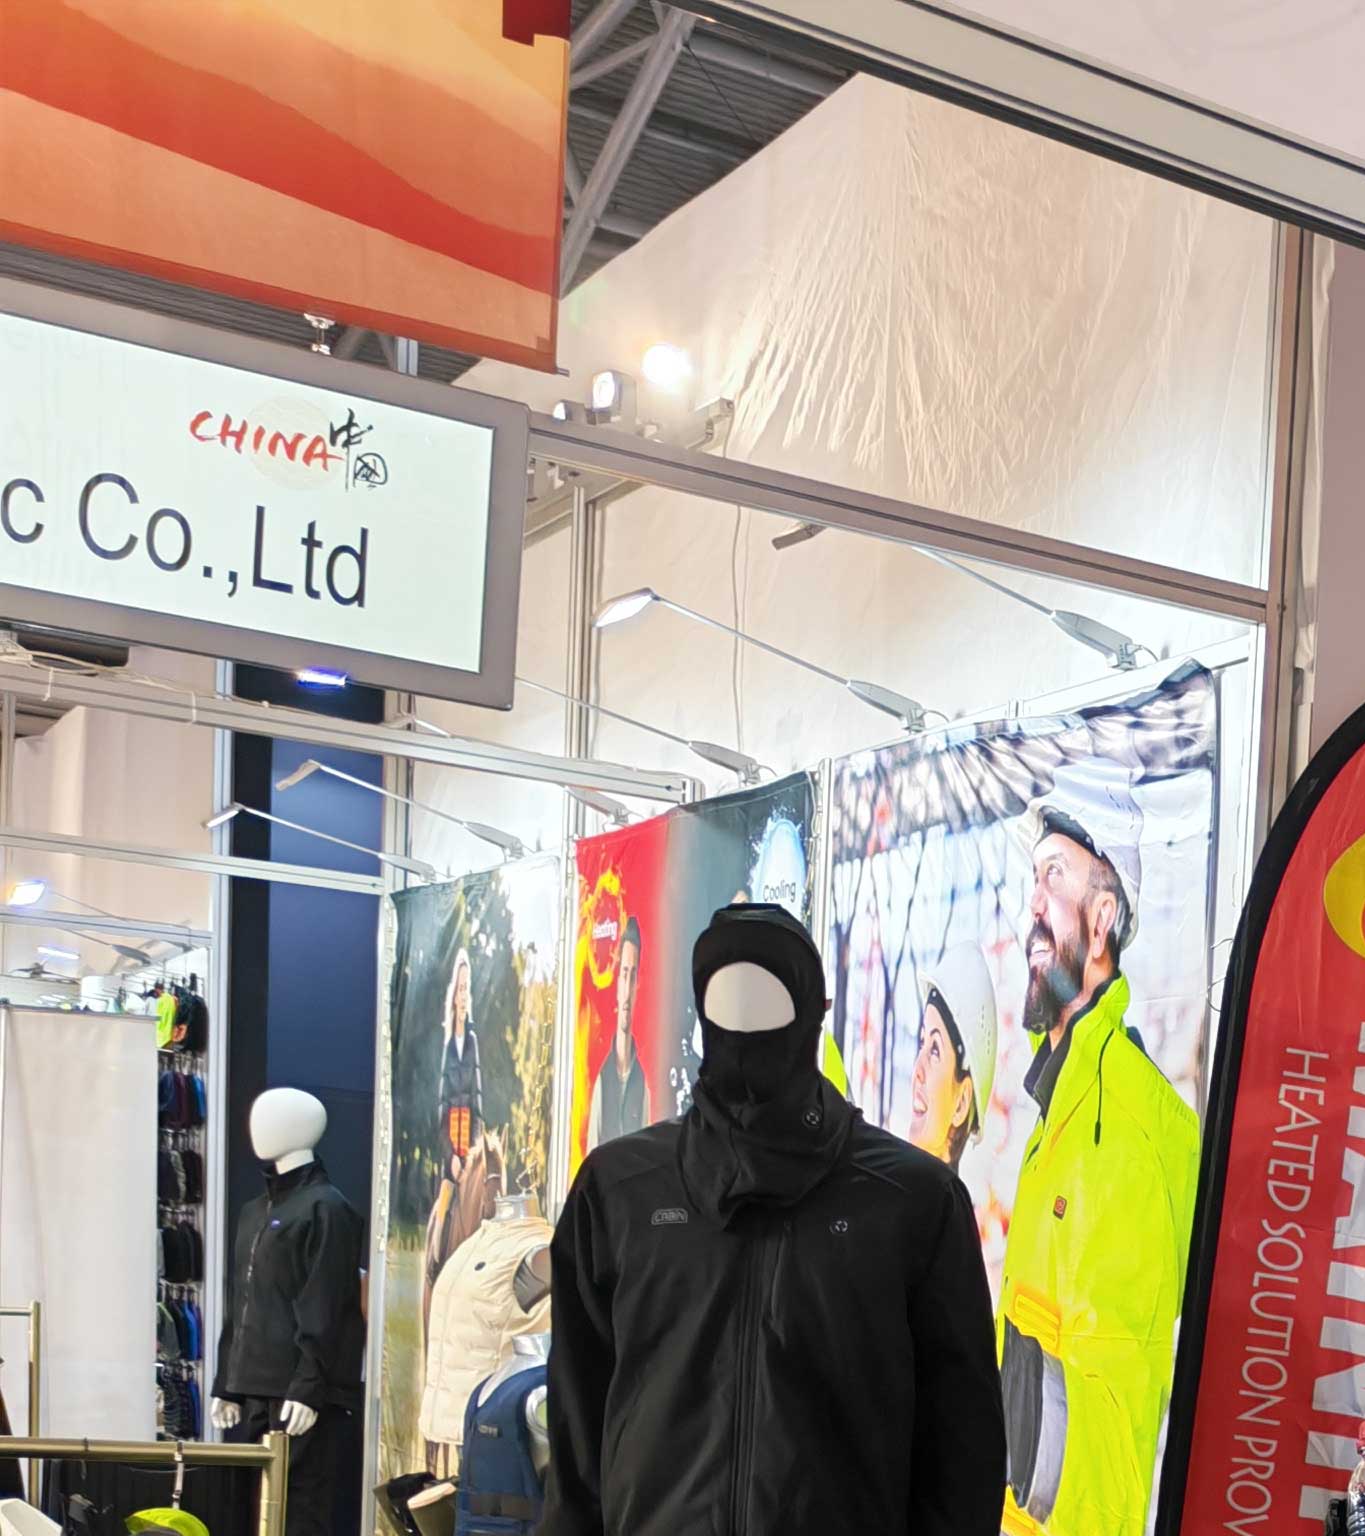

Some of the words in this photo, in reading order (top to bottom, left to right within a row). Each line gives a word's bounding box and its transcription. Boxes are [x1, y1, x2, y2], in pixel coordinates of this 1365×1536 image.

[189, 410, 344, 471] CHINA
[78, 472, 369, 608] Co.,Ltd
[763, 879, 796, 903] Cooling
[1266, 1047, 1330, 1213] HEATED
[1233, 1217, 1304, 1425] SOLUTION
